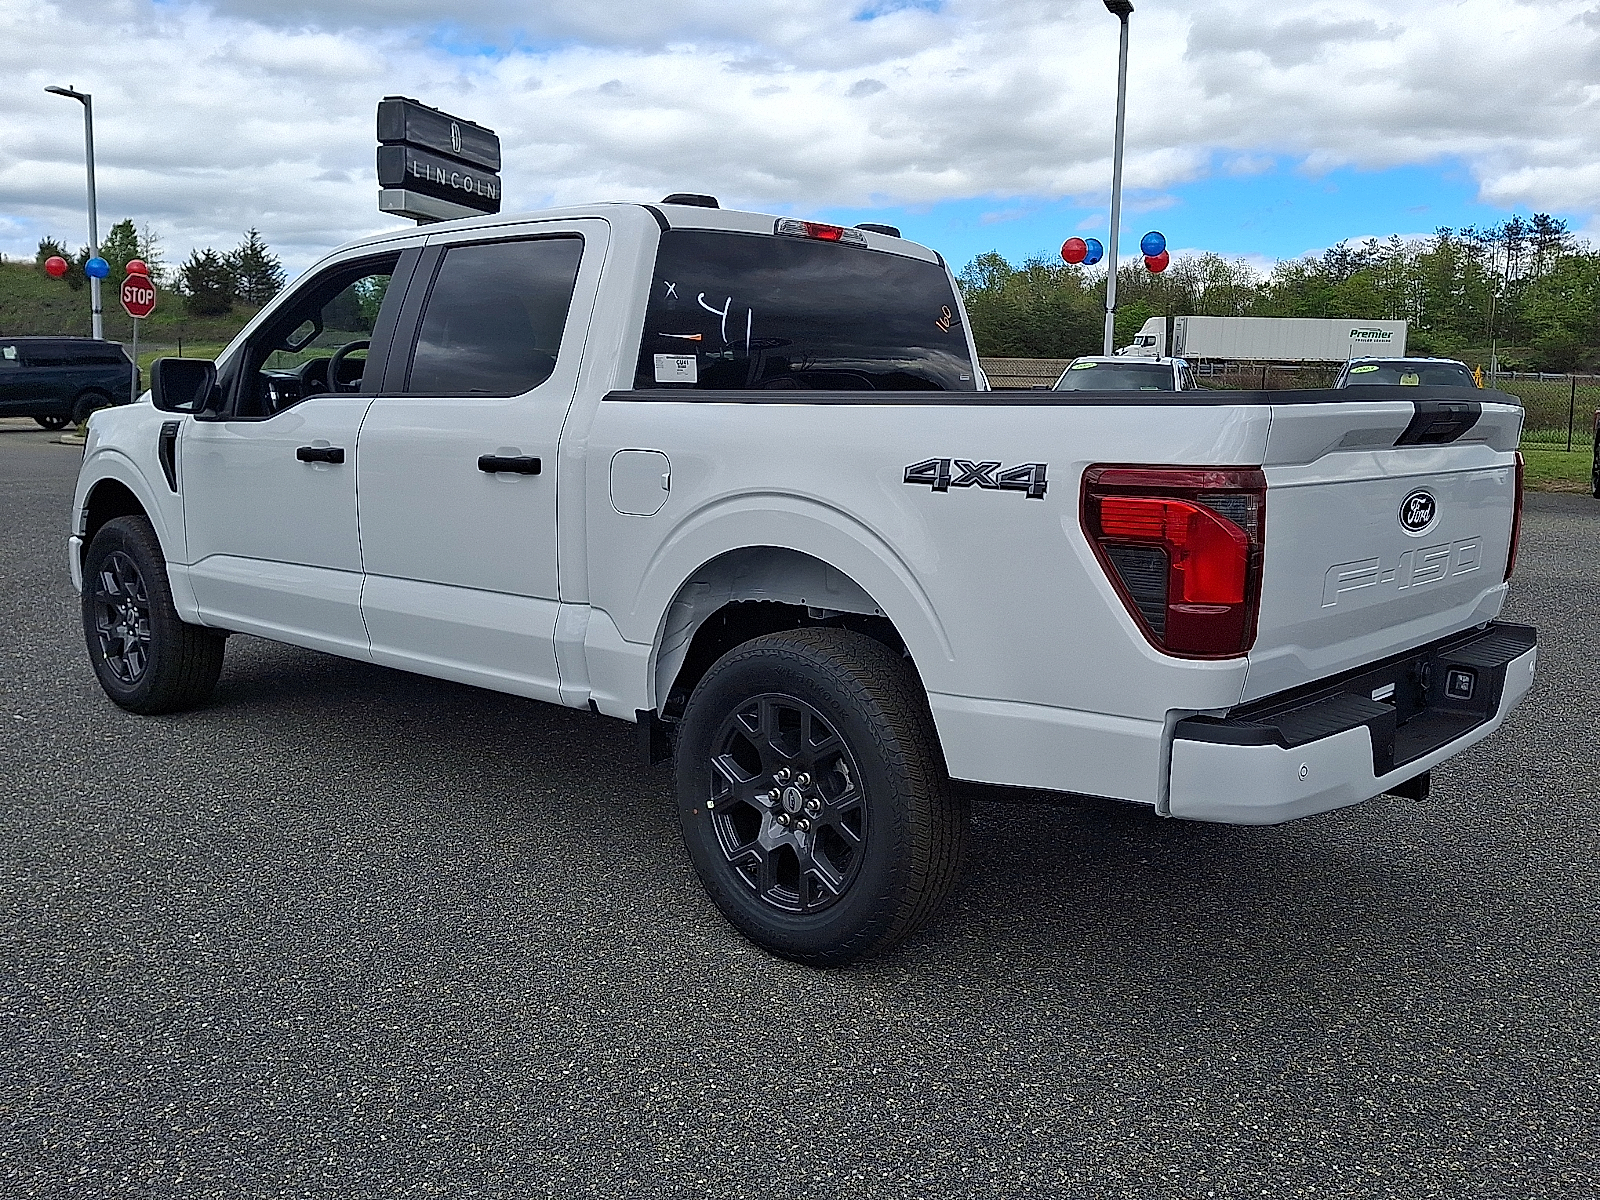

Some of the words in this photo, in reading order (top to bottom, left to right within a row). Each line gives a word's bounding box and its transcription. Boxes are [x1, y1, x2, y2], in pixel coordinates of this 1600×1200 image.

[413, 160, 496, 200] LINCOLN
[123, 286, 154, 305] STOP
[697, 292, 753, 357] 41
[935, 304, 952, 333] 160
[1349, 329, 1394, 339] Premier
[1407, 498, 1432, 524] Ford
[1321, 535, 1484, 609] F-150
